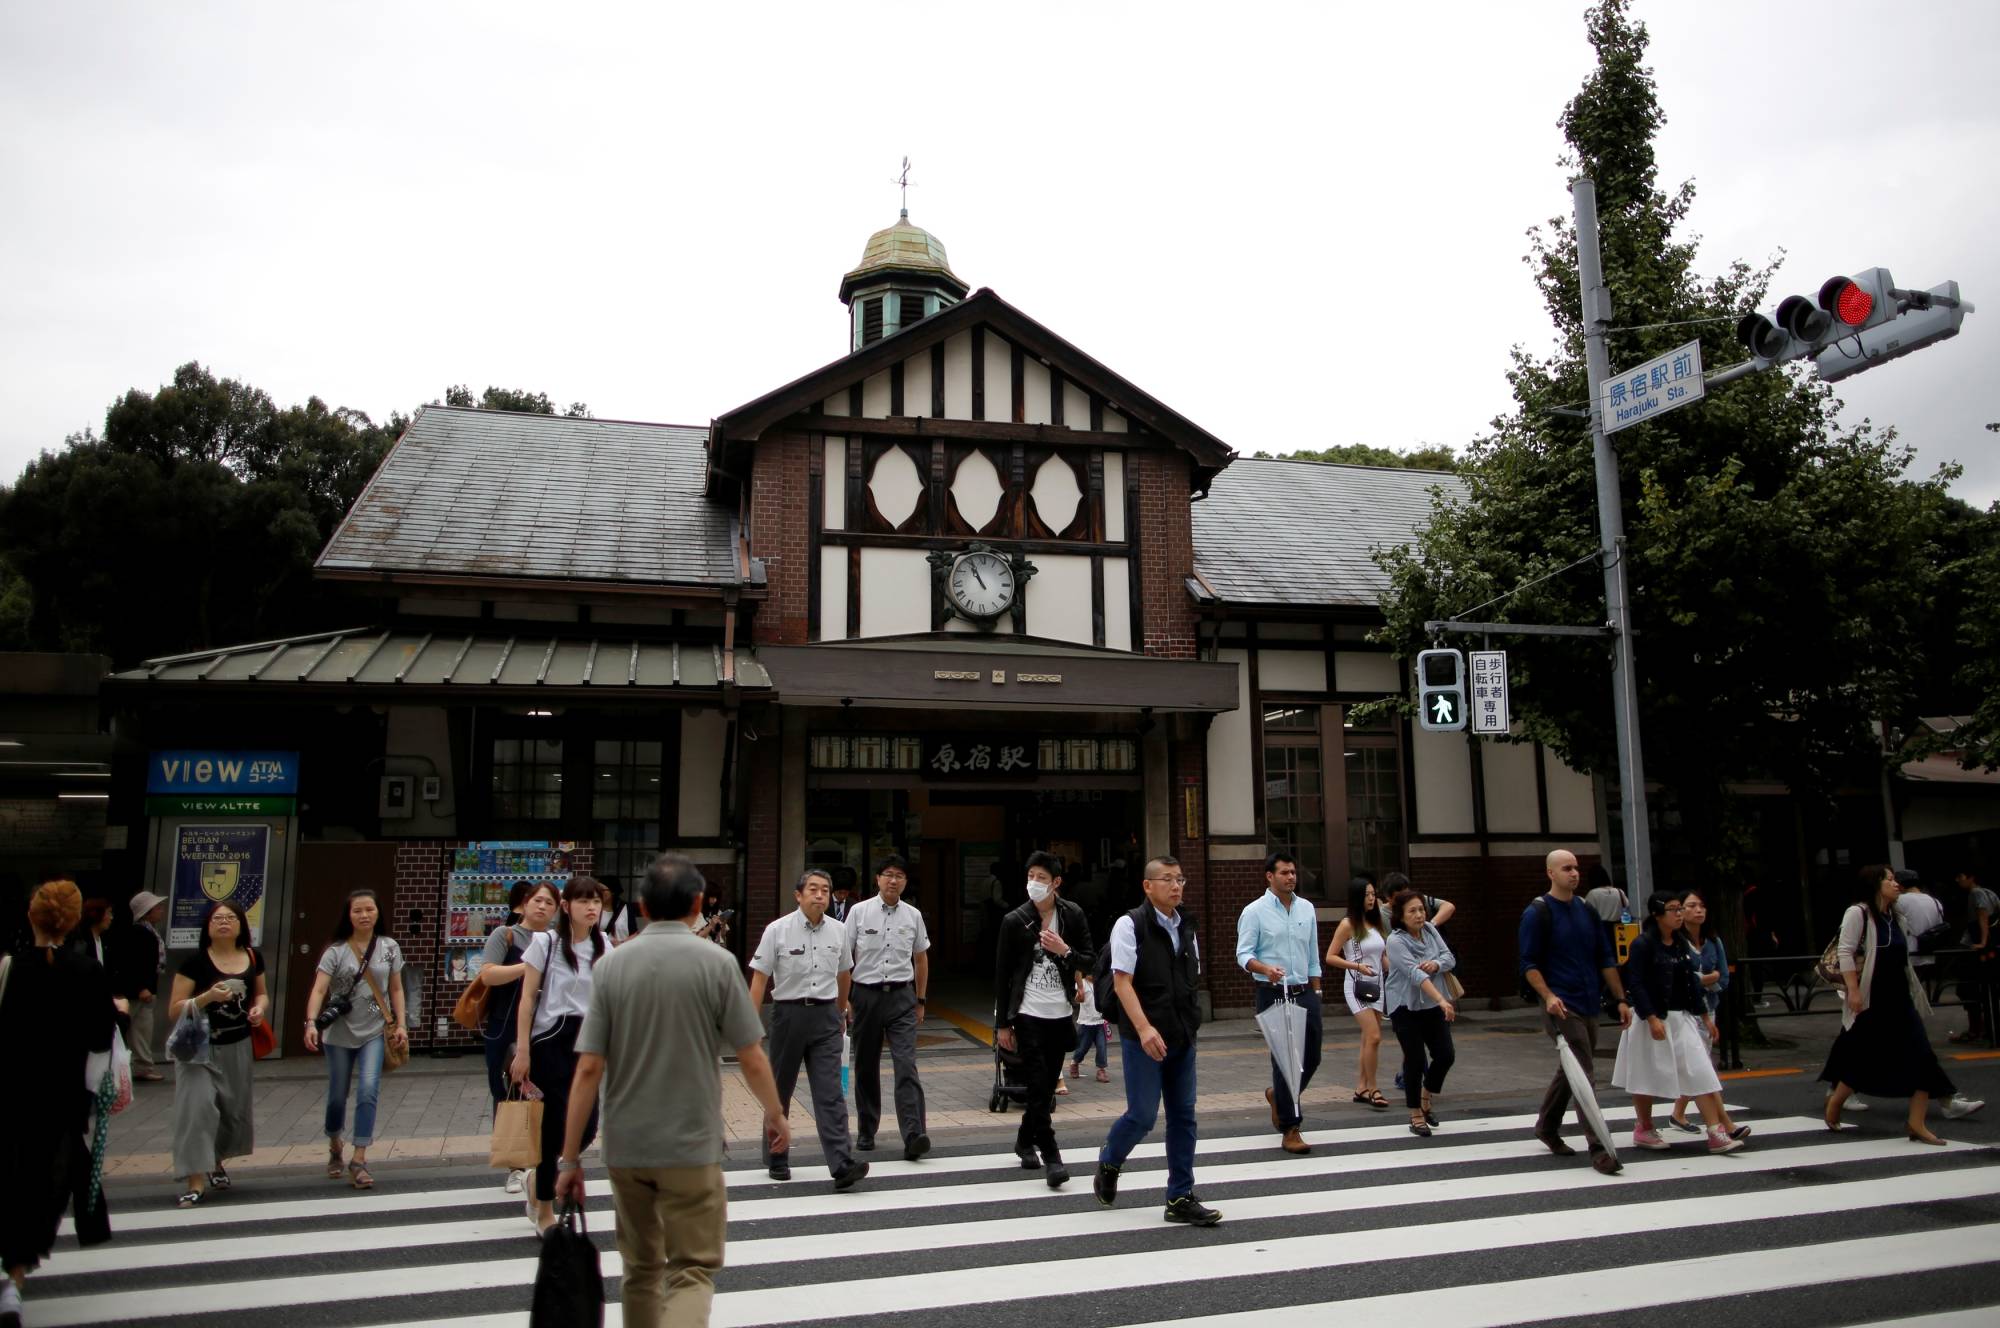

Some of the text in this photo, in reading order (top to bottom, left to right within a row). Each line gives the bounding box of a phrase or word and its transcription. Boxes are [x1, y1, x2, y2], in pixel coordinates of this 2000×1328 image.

[1610, 353, 1692, 408] 原宿駅前
[1616, 386, 1688, 422] Harajuku Sta.
[1475, 659, 1488, 699] 自転車
[1489, 658, 1503, 699] 歩行者
[1484, 701, 1496, 727] 専用
[251, 761, 283, 773] ATM
[930, 742, 1032, 774] 原宿駅
[249, 773, 285, 783] コーナー
[182, 836, 219, 844] BELGIAN
[181, 852, 250, 860] WEEKEND 2016
